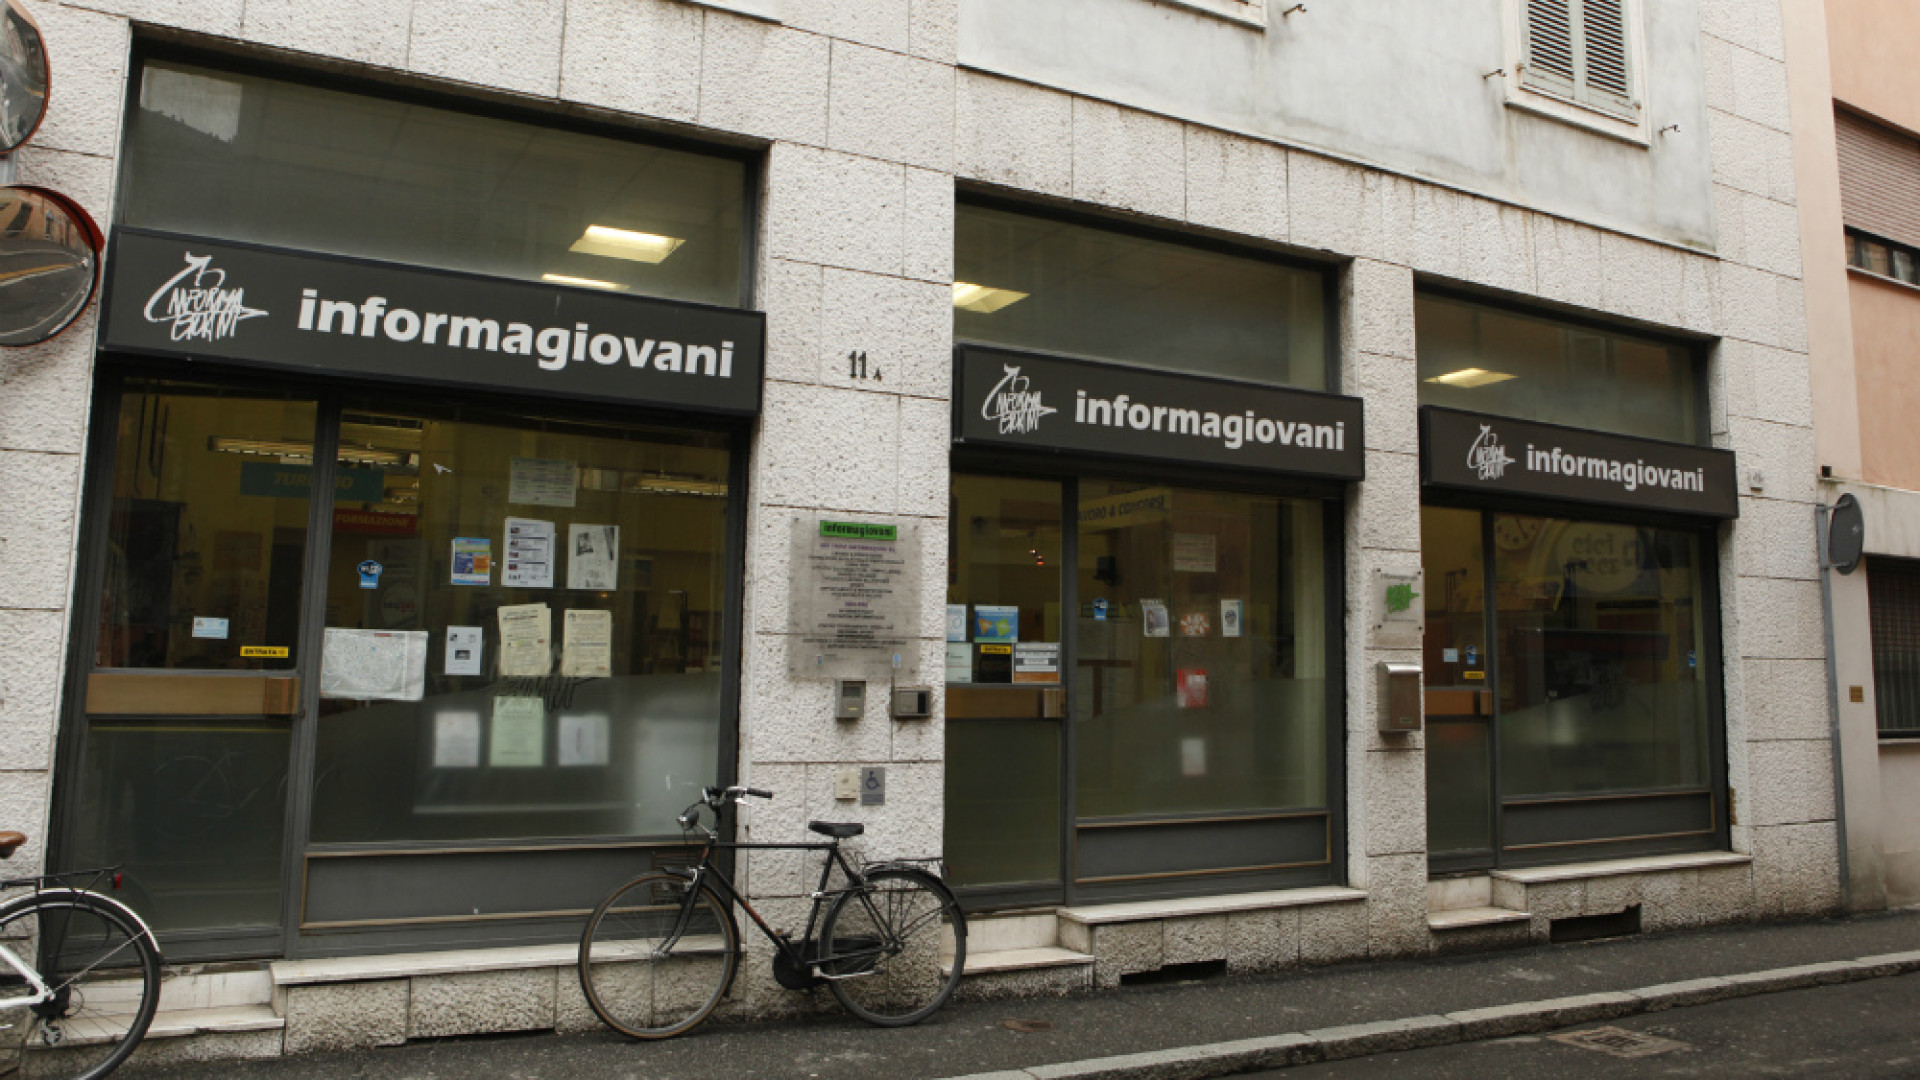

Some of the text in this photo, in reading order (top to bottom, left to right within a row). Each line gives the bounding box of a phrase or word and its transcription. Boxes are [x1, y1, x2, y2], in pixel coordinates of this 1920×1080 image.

[298, 289, 734, 378] informagiovani
[848, 350, 867, 379] 11
[1075, 389, 1344, 451] informagiovani
[1527, 443, 1704, 492] informagiovani
